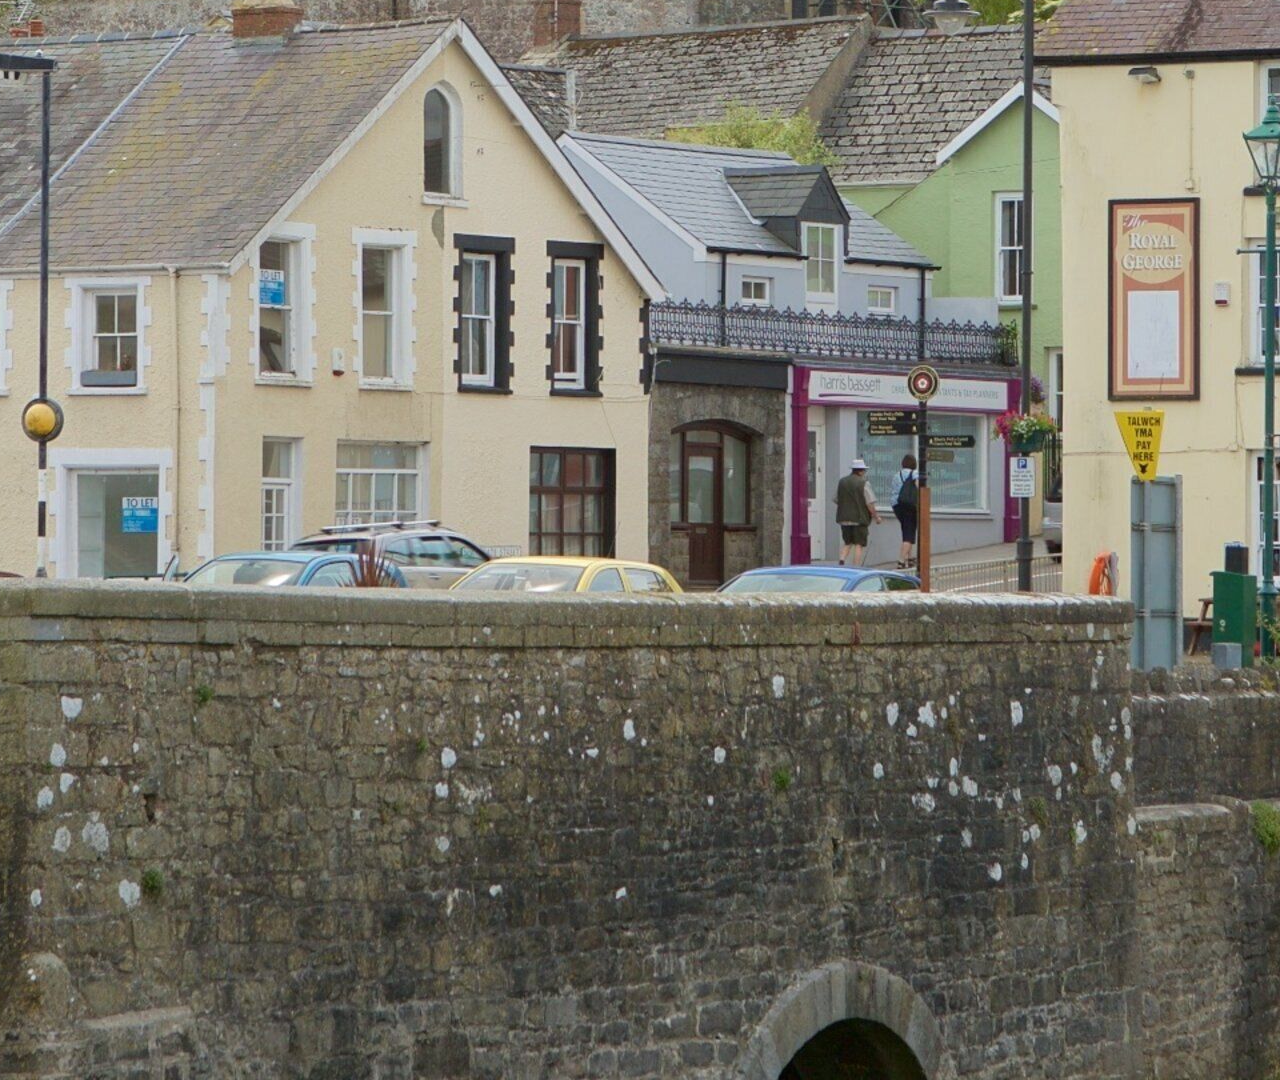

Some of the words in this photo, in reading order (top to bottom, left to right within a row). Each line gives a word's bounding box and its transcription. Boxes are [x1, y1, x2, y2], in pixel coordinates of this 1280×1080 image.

[1129, 232, 1177, 250] ROYAL
[1122, 253, 1183, 270] GEORGE
[820, 374, 847, 390] harris
[848, 375, 881, 392] bassett
[1128, 416, 1161, 426] TALWCH
[1135, 428, 1153, 438] YMA
[1136, 440, 1151, 450] PAY
[1133, 452, 1154, 462] HERE
[127, 499, 137, 507] TO
[141, 499, 153, 507] LET
